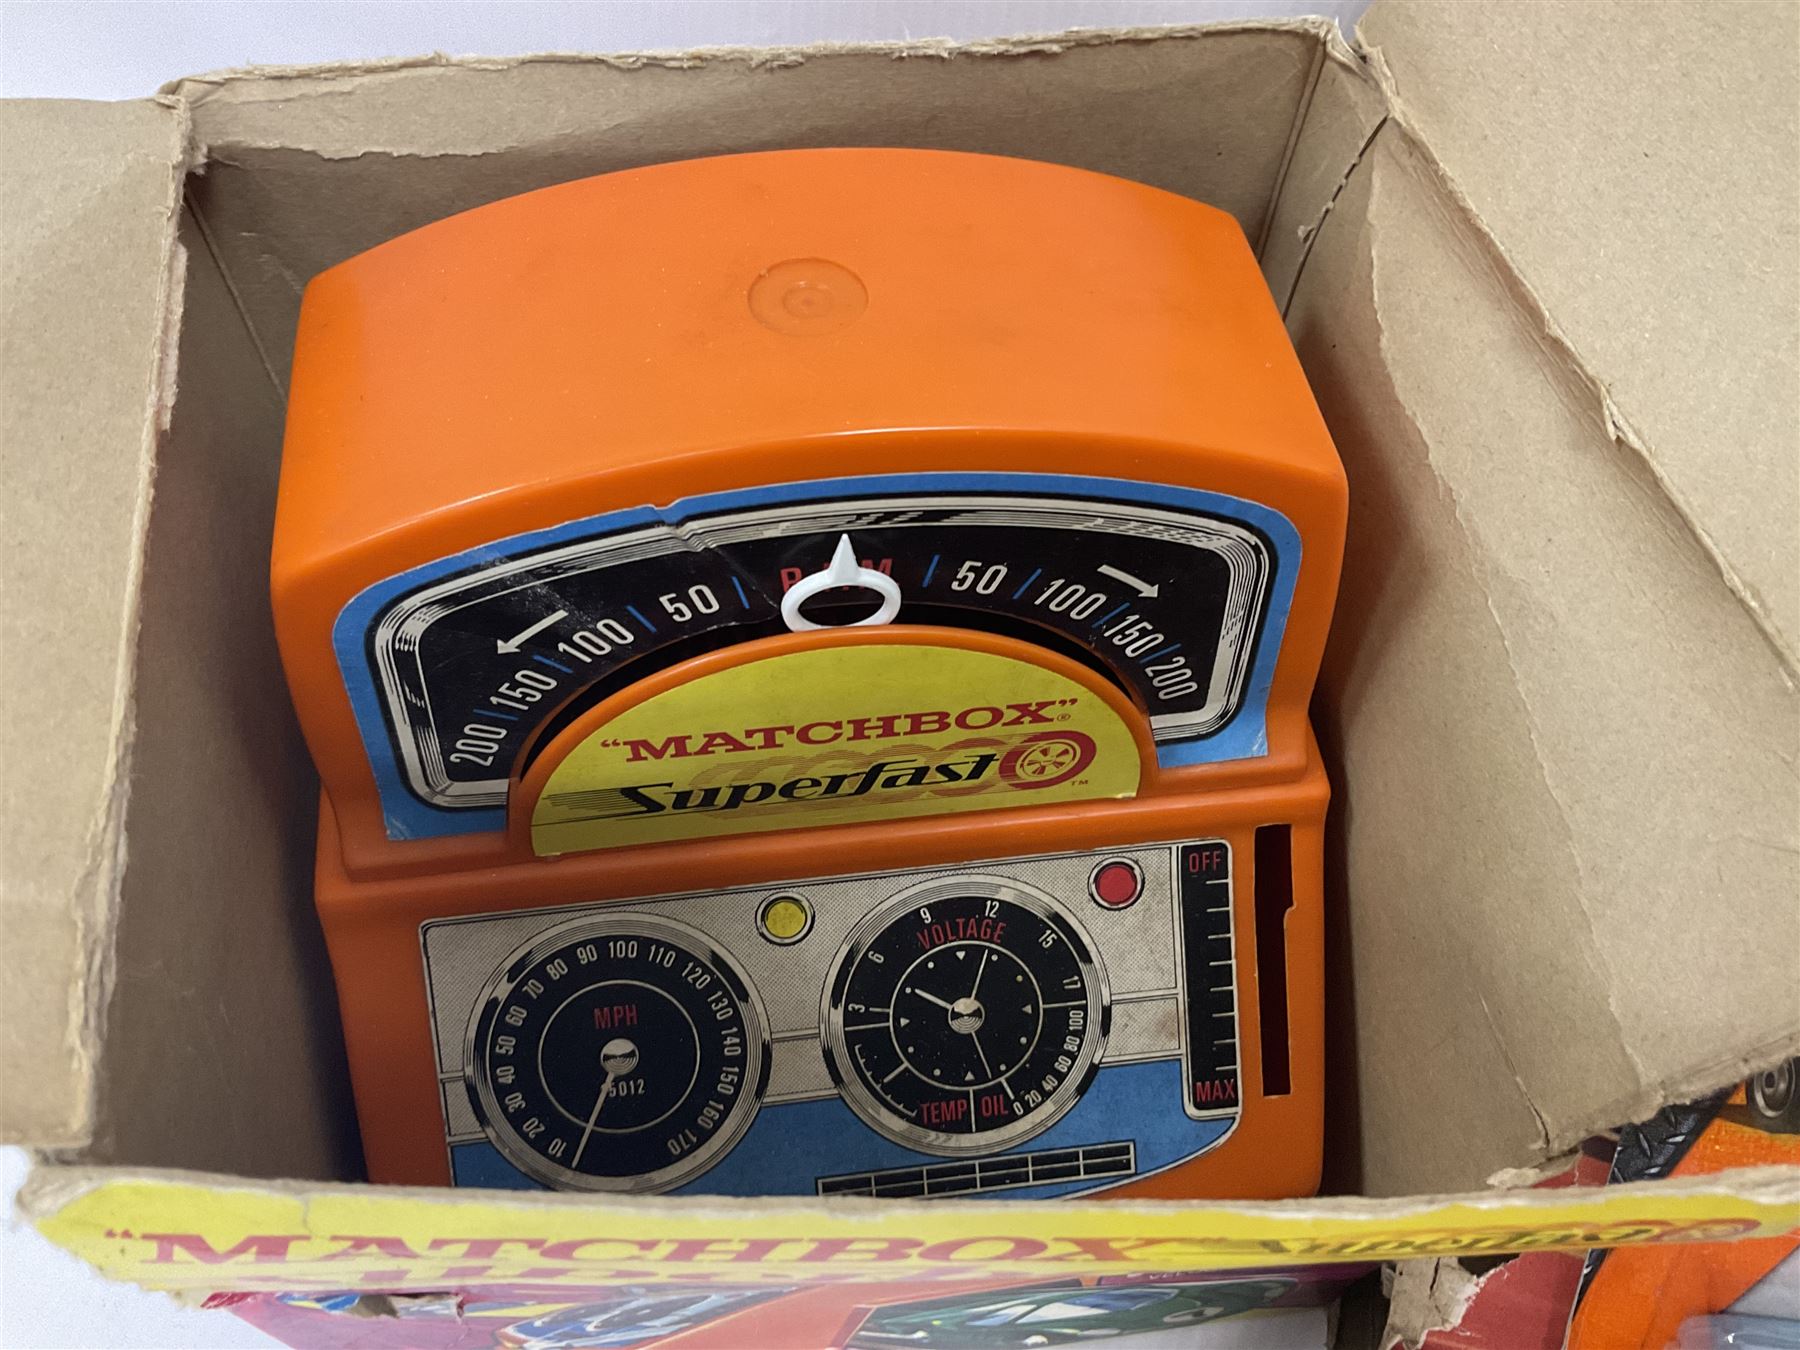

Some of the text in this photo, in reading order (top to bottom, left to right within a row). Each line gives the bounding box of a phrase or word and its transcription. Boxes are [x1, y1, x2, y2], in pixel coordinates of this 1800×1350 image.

[951, 560, 1008, 595] 50
[1034, 578, 1107, 620] 100
[1103, 614, 1165, 658] 150
[1144, 656, 1198, 700] 200
[450, 584, 720, 767] 200 150 100 50
[617, 752, 1000, 815] Superfast
[1188, 850, 1221, 873] OFF
[920, 907, 932, 924] 9
[984, 900, 999, 918] 12
[917, 917, 1006, 950] VOLTAGE
[1038, 929, 1057, 949] 15
[576, 944, 598, 965] 90
[608, 941, 638, 959] 100
[649, 945, 676, 968] 110
[868, 950, 884, 964] 6
[546, 959, 568, 980] 80
[682, 962, 711, 990] 120
[522, 979, 544, 999] 70
[1063, 975, 1081, 990] 17
[506, 1006, 527, 1026] 60
[707, 991, 733, 1021] 130
[848, 1003, 865, 1013] 3
[593, 1004, 638, 1030] MPH
[1068, 1009, 1084, 1031] 100
[496, 1036, 516, 1056] 50
[721, 1026, 742, 1057] 140
[1063, 1035, 1081, 1053] 80
[1054, 1055, 1072, 1072] 60
[496, 1065, 515, 1084] 40
[716, 1066, 740, 1095] 150
[1041, 1074, 1059, 1092] 40
[1025, 1090, 1042, 1108] 20
[1195, 1078, 1236, 1103] MAX
[505, 1092, 526, 1112] 30
[920, 1098, 967, 1125] TEMP
[980, 1094, 1009, 1117] OIL
[1013, 1101, 1024, 1116] 0
[697, 1101, 724, 1130] 160
[522, 1118, 545, 1138] 20
[549, 1138, 567, 1158] 10
[667, 1129, 697, 1156] 170
